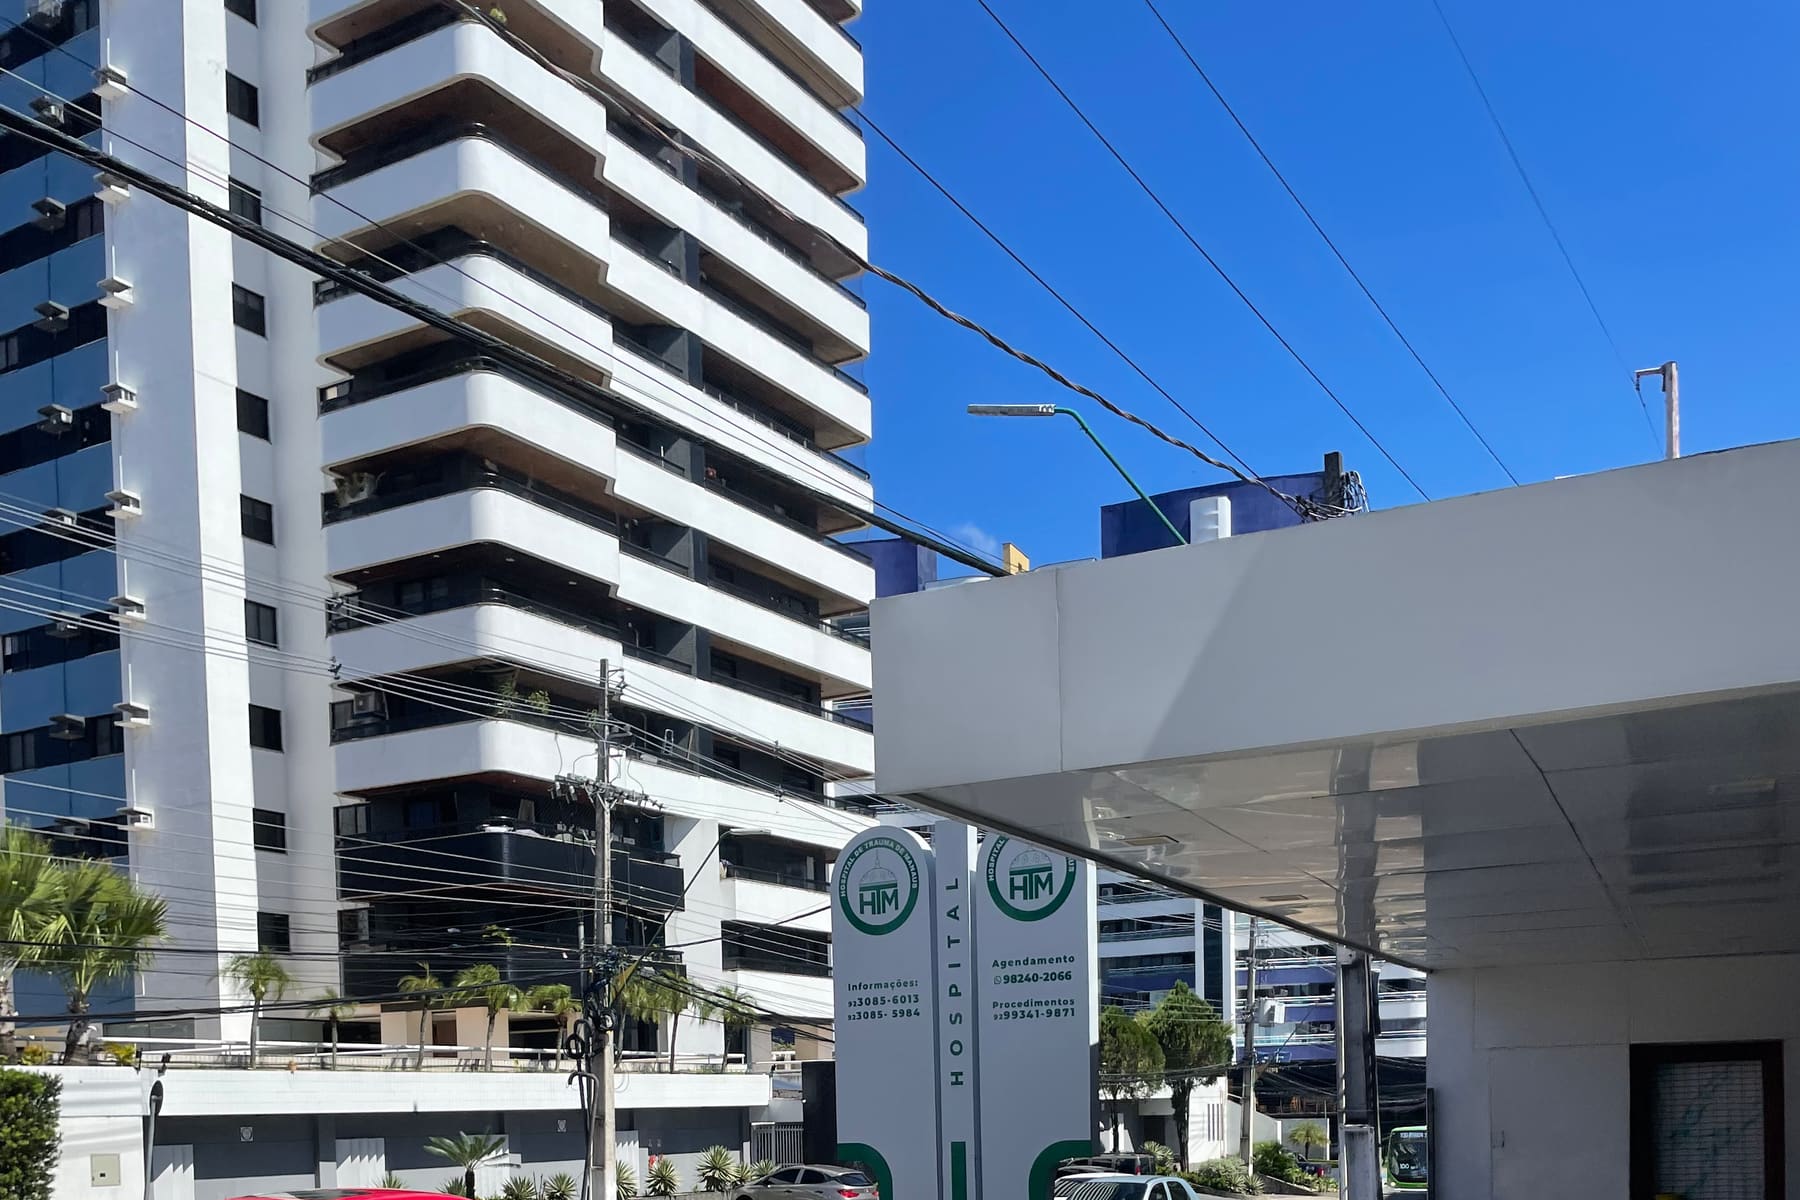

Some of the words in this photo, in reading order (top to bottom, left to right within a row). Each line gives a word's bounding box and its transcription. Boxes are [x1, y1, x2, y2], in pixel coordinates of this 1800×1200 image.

[1009, 866, 1053, 900] HTM
[859, 882, 900, 915] HTM
[992, 955, 1075, 969] Agendamento
[946, 878, 964, 1086] HOSPITAL
[1003, 971, 1072, 984] 98240-2066
[847, 979, 918, 991] Informações:
[992, 998, 1075, 1009] Procedimentos
